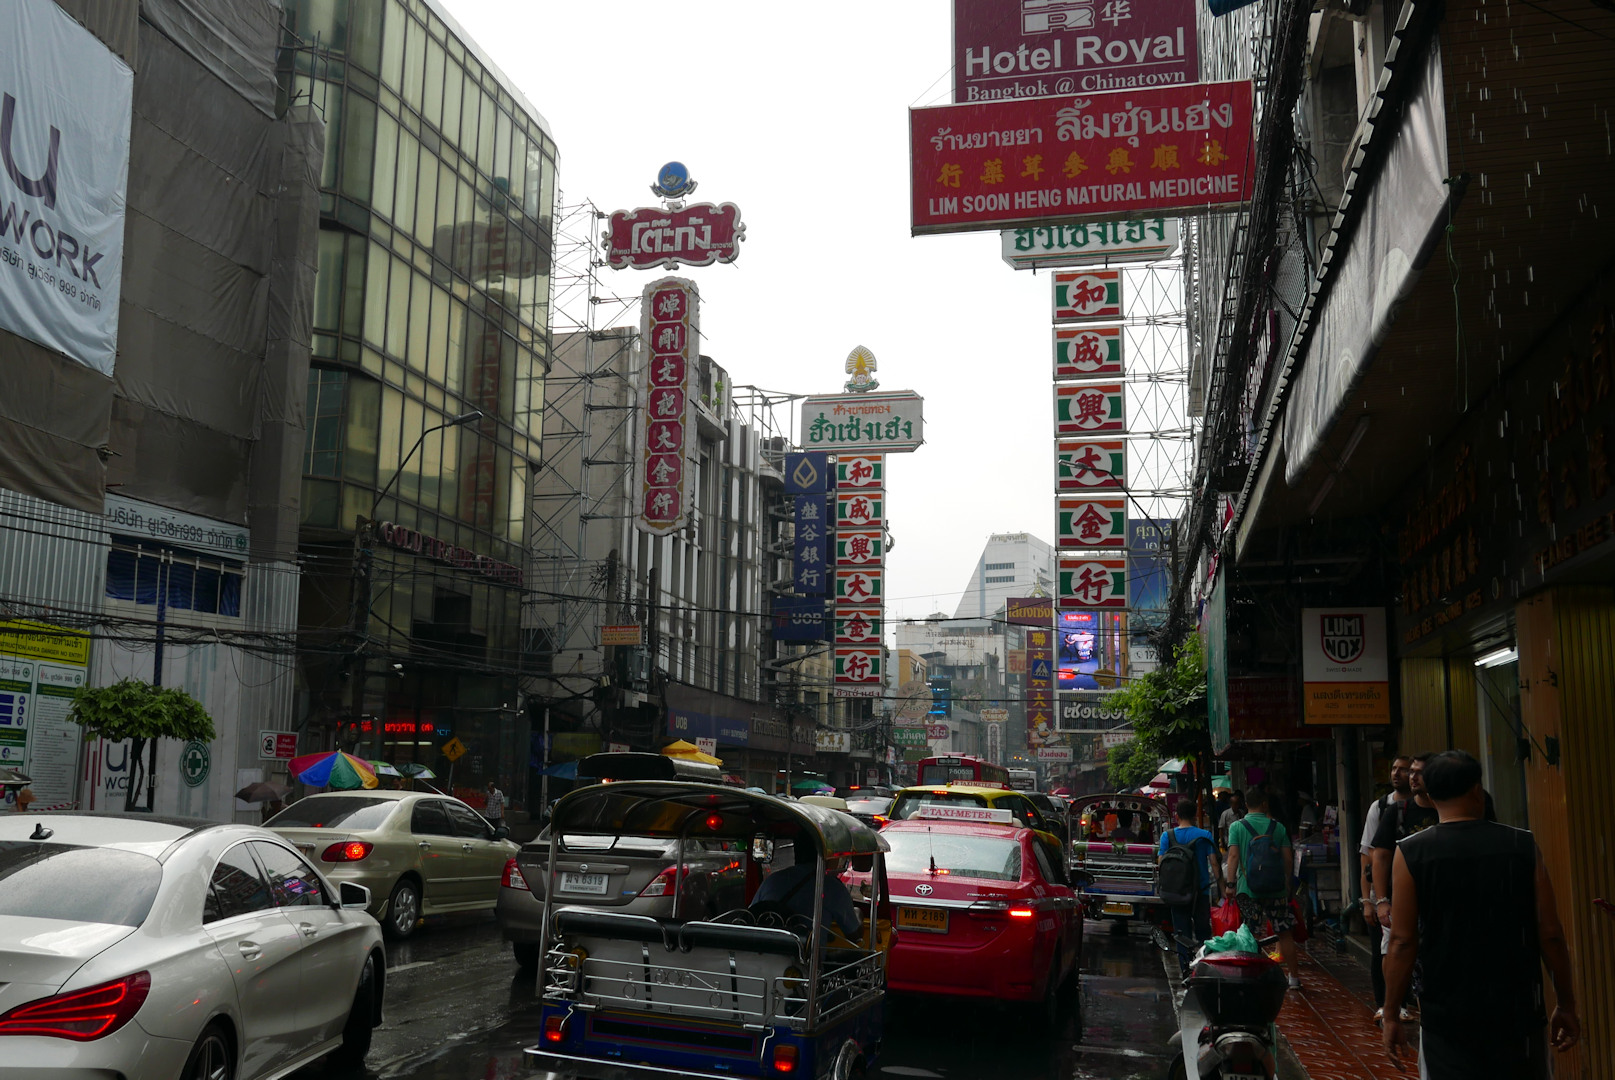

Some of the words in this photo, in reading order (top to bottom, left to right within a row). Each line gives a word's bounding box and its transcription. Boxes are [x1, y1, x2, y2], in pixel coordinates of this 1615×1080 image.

[965, 38, 1062, 77] Hotel
[1076, 27, 1185, 66] Royal
[966, 82, 1048, 101] Bangkok
[1054, 77, 1075, 96] @
[1081, 70, 1186, 91] Chinatown
[930, 127, 1043, 152] ร้านขายยา
[930, 195, 959, 216] LIM
[962, 193, 1011, 214] SOON
[1014, 189, 1062, 210] HENG
[1066, 183, 1146, 206] NATURAL
[1154, 174, 1239, 200] MEDICINE
[0, 201, 104, 290] WORK
[0, 246, 24, 270] ริษัท
[1072, 280, 1111, 601] 和成興大金行
[382, 521, 422, 552] GOLD
[1136, 523, 1172, 539] ศุภาลั
[845, 461, 874, 681] 和成興大金行
[792, 612, 822, 625] UOB
[1324, 616, 1360, 636] LUMI
[1326, 638, 1360, 658] NOX
[675, 715, 688, 730] UOB
[930, 808, 993, 819] TAXI-METER
[581, 874, 603, 886] 6319
[921, 910, 945, 922] 2189
